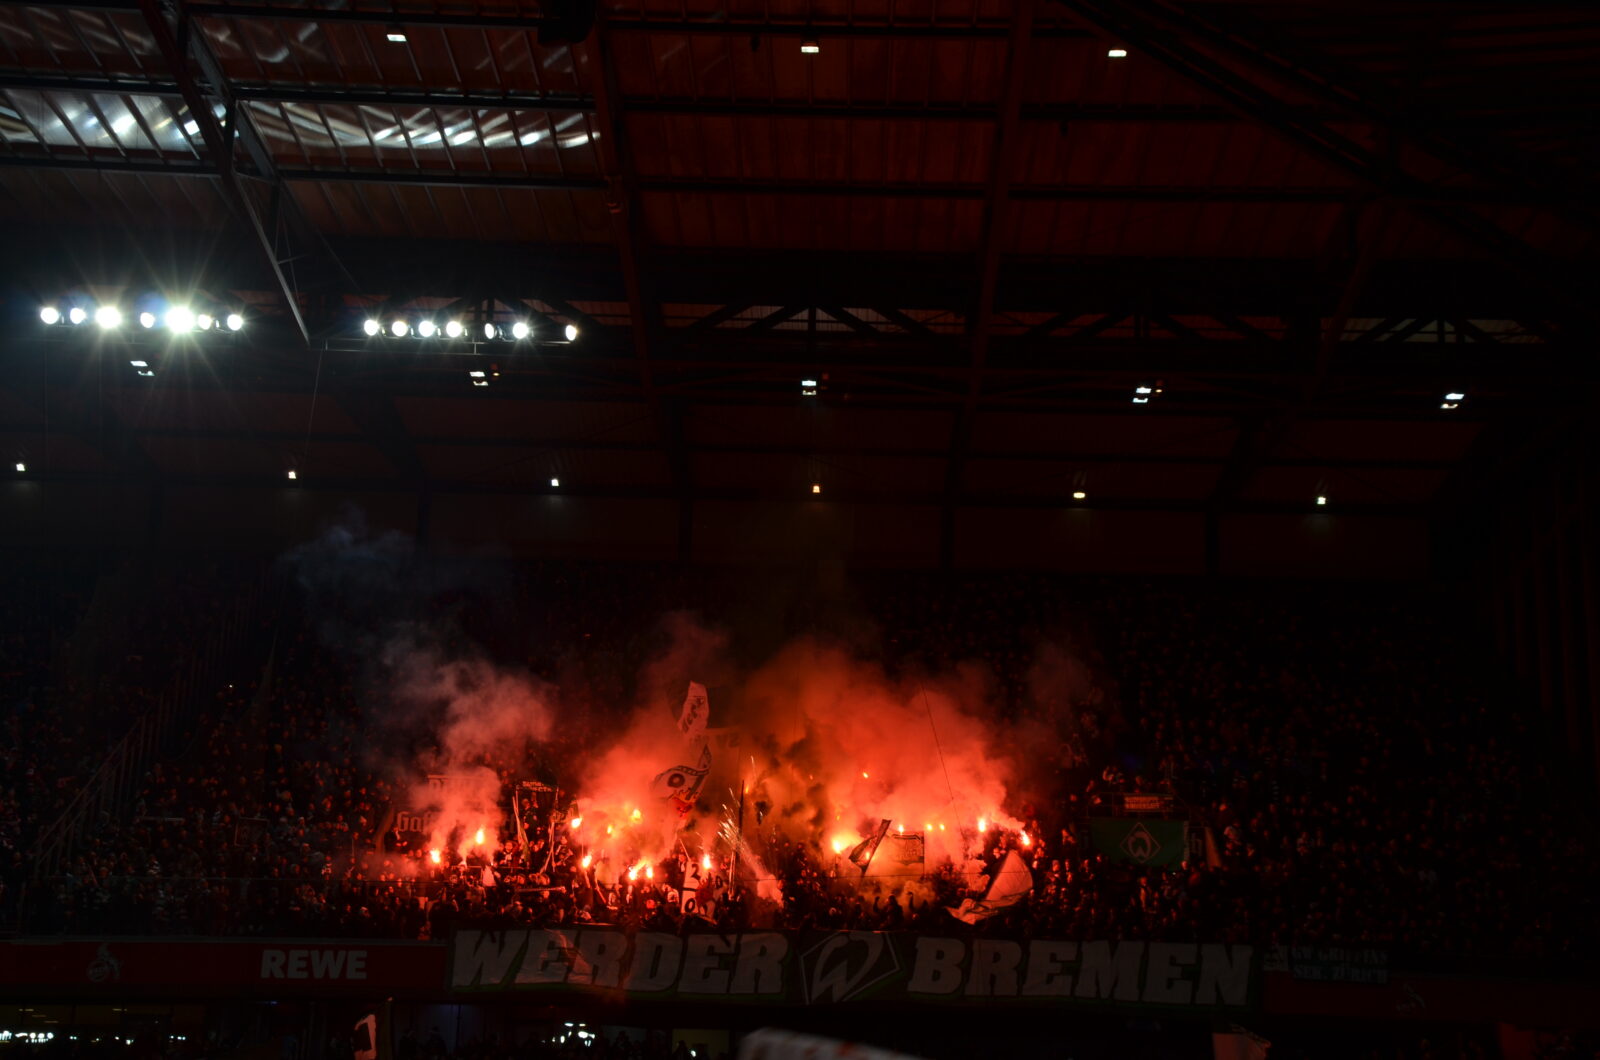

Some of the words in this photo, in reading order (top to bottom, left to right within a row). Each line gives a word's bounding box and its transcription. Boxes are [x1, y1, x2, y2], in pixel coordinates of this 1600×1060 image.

[260, 949, 368, 981] REWE
[451, 928, 788, 995] WERDER
[907, 937, 1254, 1006] BREMEN
